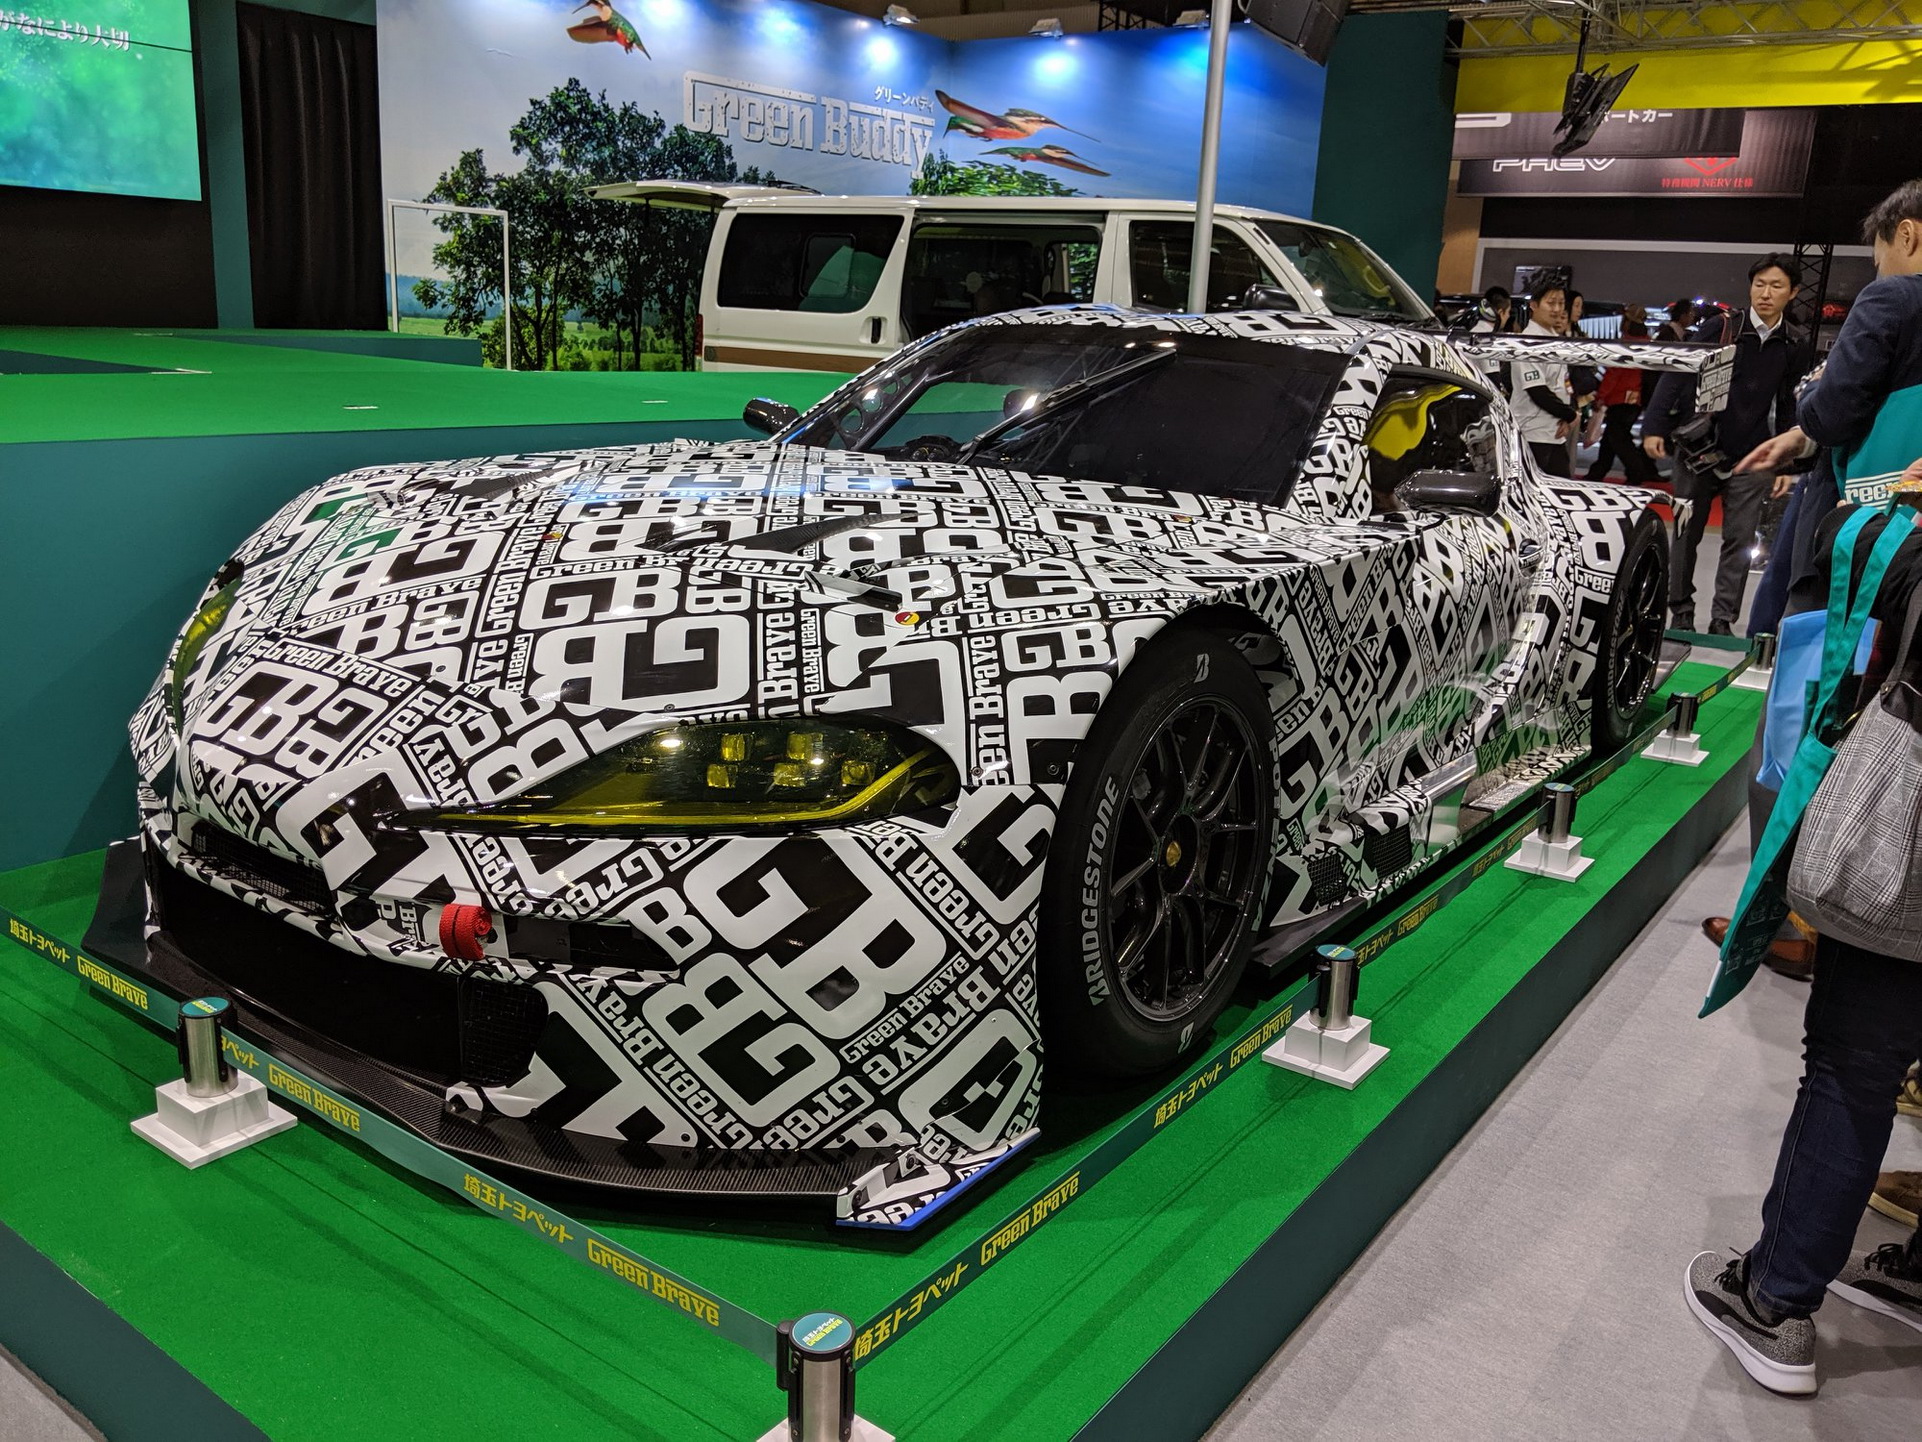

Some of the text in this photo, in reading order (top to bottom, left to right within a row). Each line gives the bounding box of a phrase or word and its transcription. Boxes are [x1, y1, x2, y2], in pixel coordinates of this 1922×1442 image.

[682, 71, 936, 179] Green Buddy
[874, 85, 935, 113] グリーンバディ
[1702, 178, 1732, 189] NERV
[371, 575, 485, 611] Brave
[518, 567, 681, 632] GB
[529, 558, 638, 580] Green
[1575, 566, 1616, 594] Gree
[264, 637, 413, 698] Green Brave
[763, 612, 799, 703] Brave
[968, 634, 1003, 721] Brave
[1001, 624, 1113, 672] GB
[904, 850, 1001, 961] Green
[1080, 776, 1121, 1007] BRIDGESTONE
[9, 917, 71, 964] 埼玉トヨペット
[77, 955, 113, 992] Green
[111, 975, 149, 1011] Brave
[1356, 929, 1394, 966] 玉トヨペット
[1397, 909, 1421, 937] Green
[838, 951, 971, 1065] Green Brave
[268, 1063, 313, 1103] Green
[312, 1091, 361, 1133] Brave
[1153, 1004, 1294, 1130] 埼玉トヨペット Green Brave
[463, 1173, 721, 1328] 埼玉トヨペット Green Brave
[854, 1260, 970, 1363] 埼玉トヨペット
[980, 1203, 1032, 1267] Green
[1030, 1171, 1081, 1230] Brave
